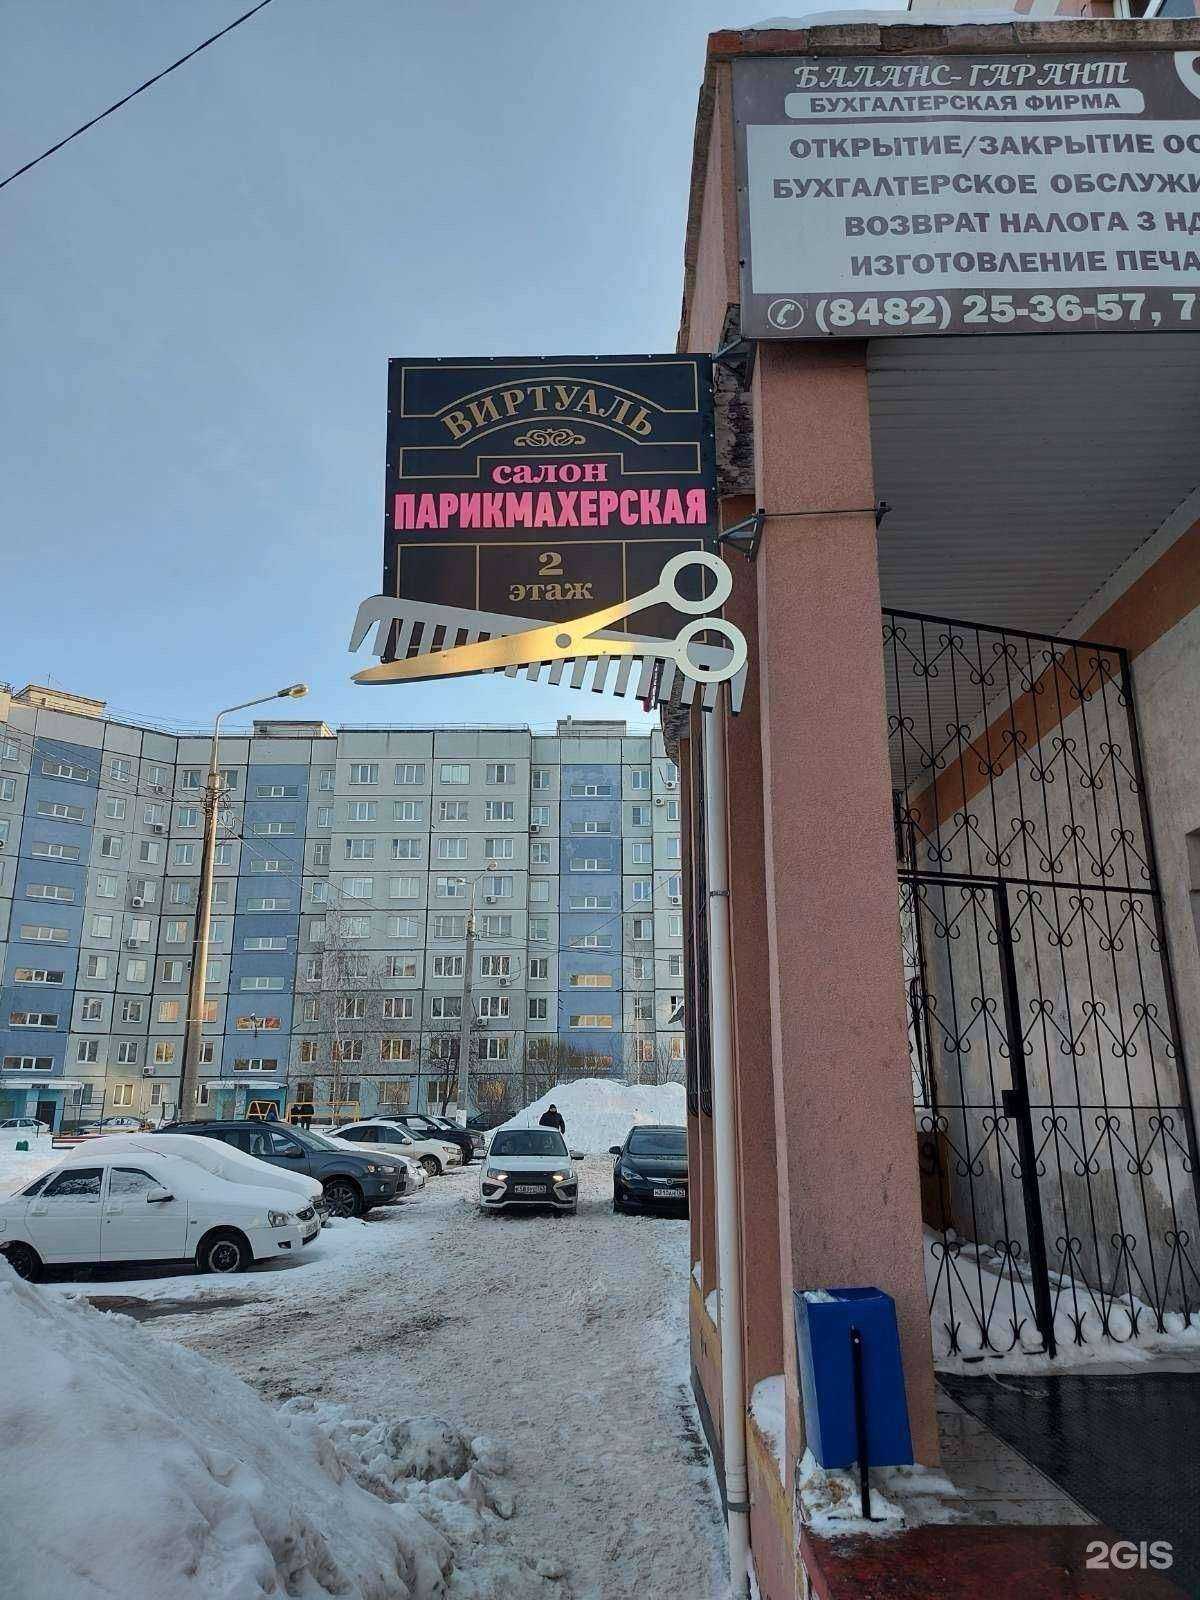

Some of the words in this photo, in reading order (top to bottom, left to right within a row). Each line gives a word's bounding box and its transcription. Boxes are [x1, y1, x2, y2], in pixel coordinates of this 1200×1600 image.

[810, 94, 1017, 113] БУХГАЛТЕРСКАЯ
[1025, 93, 1121, 110] ФИРМА
[789, 133, 1155, 159] ОТКРЫТИЕ/ЗАКРЫТИЕ
[773, 174, 1038, 199] БУХГАЛТЕРСКОЕ
[844, 212, 990, 237] ВОЗВРАТ
[1000, 211, 1129, 233] НАЛОГА
[850, 250, 1107, 277] ИЗГОТОВЛЕНИЕ
[815, 296, 952, 333] (8482)
[440, 384, 653, 440] ВИРТУАЛЬ
[492, 462, 608, 485] салон
[394, 488, 707, 530] ПАРИКМАХЕРСКАЯ
[538, 551, 564, 577] 2
[508, 581, 593, 602] этаж
